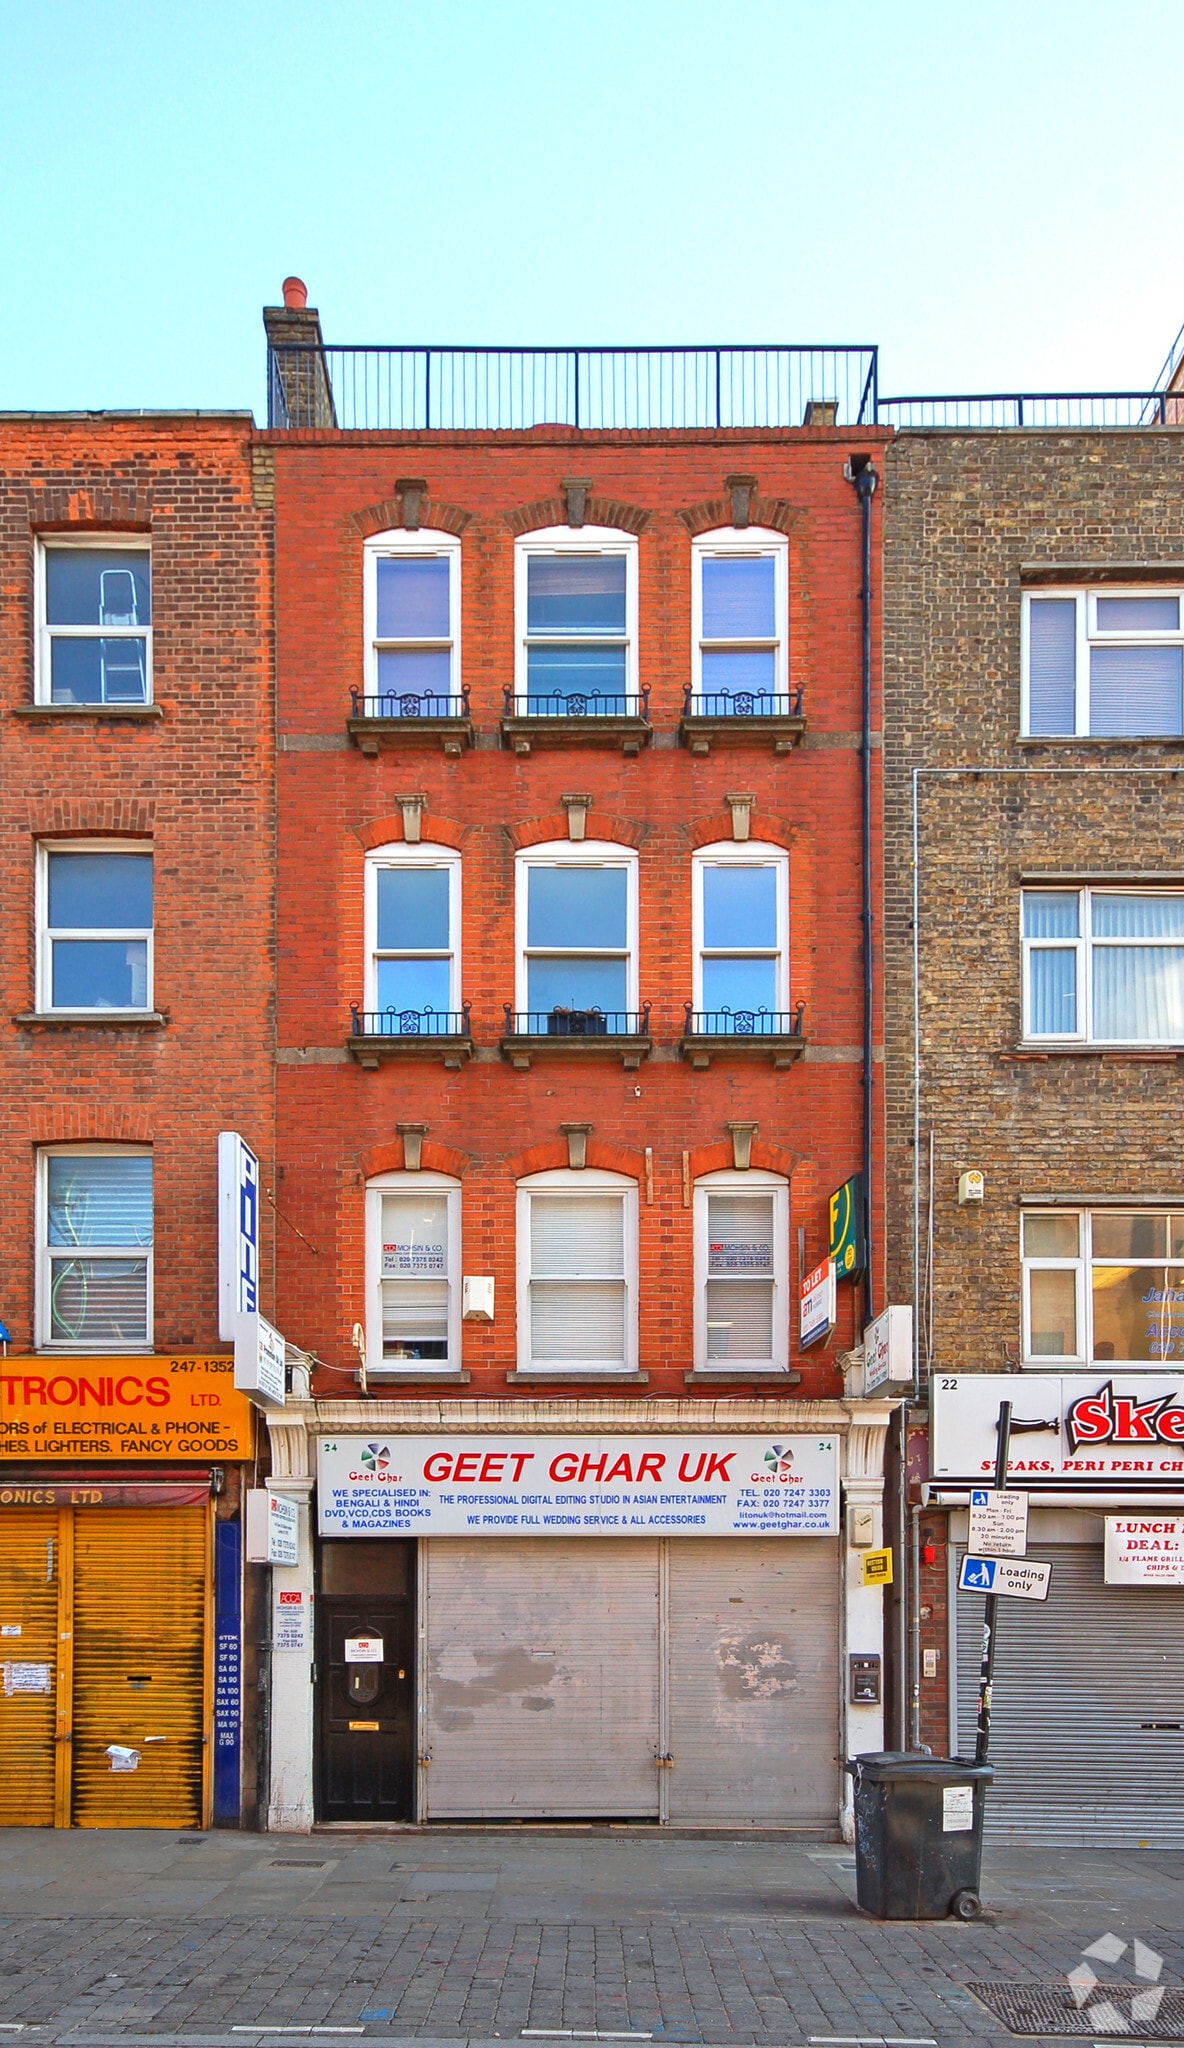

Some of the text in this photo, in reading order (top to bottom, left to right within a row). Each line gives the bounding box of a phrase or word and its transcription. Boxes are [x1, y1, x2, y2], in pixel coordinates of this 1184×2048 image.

[803, 1279, 811, 1295] TO
[811, 1267, 822, 1287] LET
[170, 1361, 234, 1373] 247-1352
[941, 1379, 958, 1390] 22
[0, 1376, 222, 1406] TRONICS LTD.
[33, 1422, 47, 1434] of
[54, 1422, 147, 1434] ELECTRICAL
[151, 1423, 161, 1434] &
[166, 1422, 220, 1434] PHONE
[121, 1440, 173, 1452] FANCY
[178, 1440, 239, 1452] GOODS
[324, 1443, 338, 1452] 24
[818, 1442, 832, 1451] 24
[423, 1452, 738, 1482] GEET GHAR UK
[1062, 1460, 1105, 1471] PERI
[1110, 1460, 1153, 1471] PERI
[349, 1471, 403, 1483] Geet Ghar
[750, 1473, 804, 1484] Geet Ghar
[0, 1490, 56, 1504] ONICS
[352, 1489, 417, 1497] SPECIALISED
[419, 1489, 432, 1497] IN:
[740, 1489, 831, 1497] TEL. 020 7247 3303
[336, 1499, 380, 1508] BENGALI
[394, 1499, 420, 1507] HINDI
[439, 1494, 728, 1505] THE PROFESSIONAL DIGITAL EDITING STUDIO IN ASIAN ENTERTAINMENT
[737, 1500, 830, 1508] FAX: 020 7247 3377
[395, 1509, 432, 1517] BOOKS
[739, 1511, 827, 1519] litonuk@hotmail.com
[341, 1520, 411, 1528] & MAGAZINES
[467, 1515, 706, 1525] WE PROVIDE FULL WEDDING SERVICE & ALL ACCESSORIES
[733, 1520, 830, 1530] www.geetghar.co.uk
[1115, 1523, 1176, 1534] LUNCH
[1126, 1540, 1179, 1550] DEAL:
[999, 1566, 1045, 1581] Loading
[1007, 1580, 1033, 1591] only
[281, 1593, 301, 1603] ACCA
